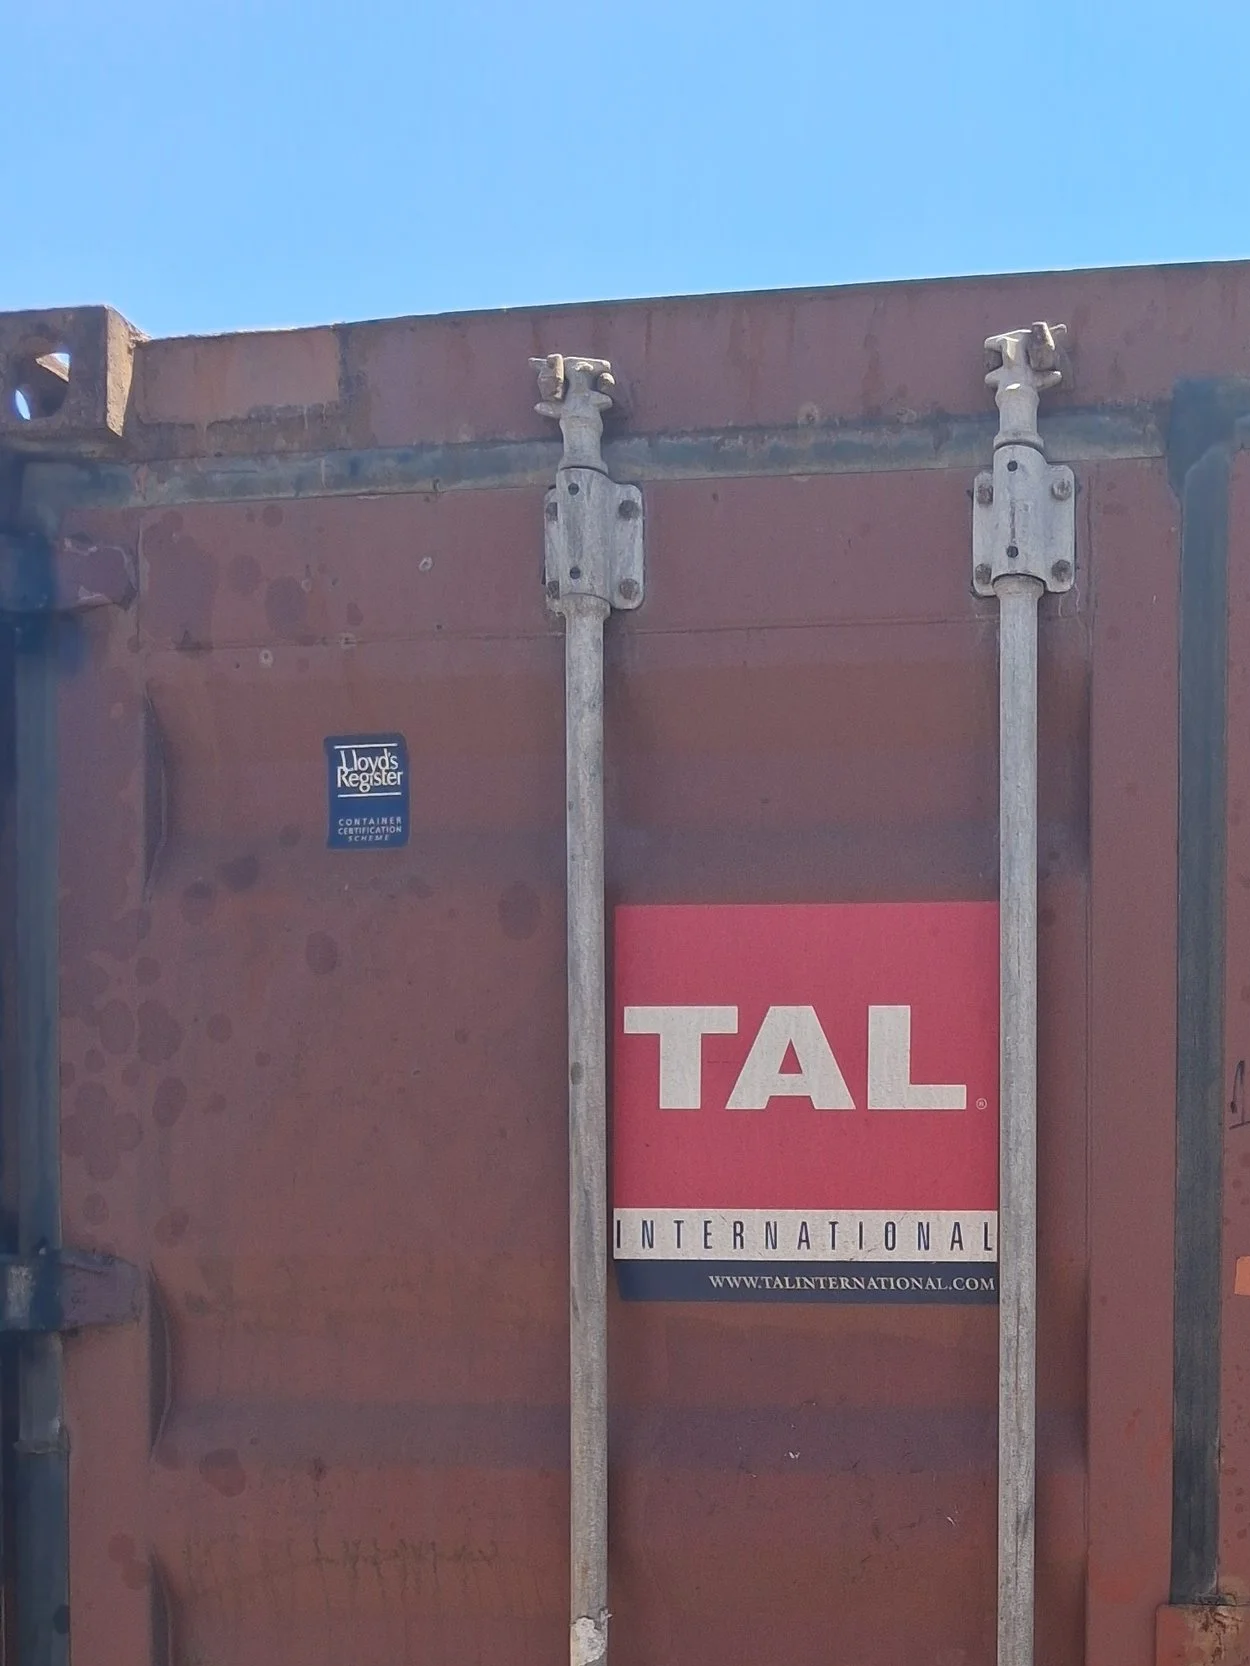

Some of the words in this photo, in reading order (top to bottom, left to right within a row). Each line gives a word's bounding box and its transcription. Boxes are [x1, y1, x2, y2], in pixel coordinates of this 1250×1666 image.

[340, 748, 398, 775] Lloyd's
[337, 766, 403, 792] Register
[338, 826, 402, 835] CERTIFICATION
[339, 817, 402, 826] CONTAINER
[624, 1005, 966, 1110] TAL
[616, 1220, 993, 1252] INTERNATIONAL
[709, 1275, 995, 1290] WWW.TALINTERNATIONAL.COM
